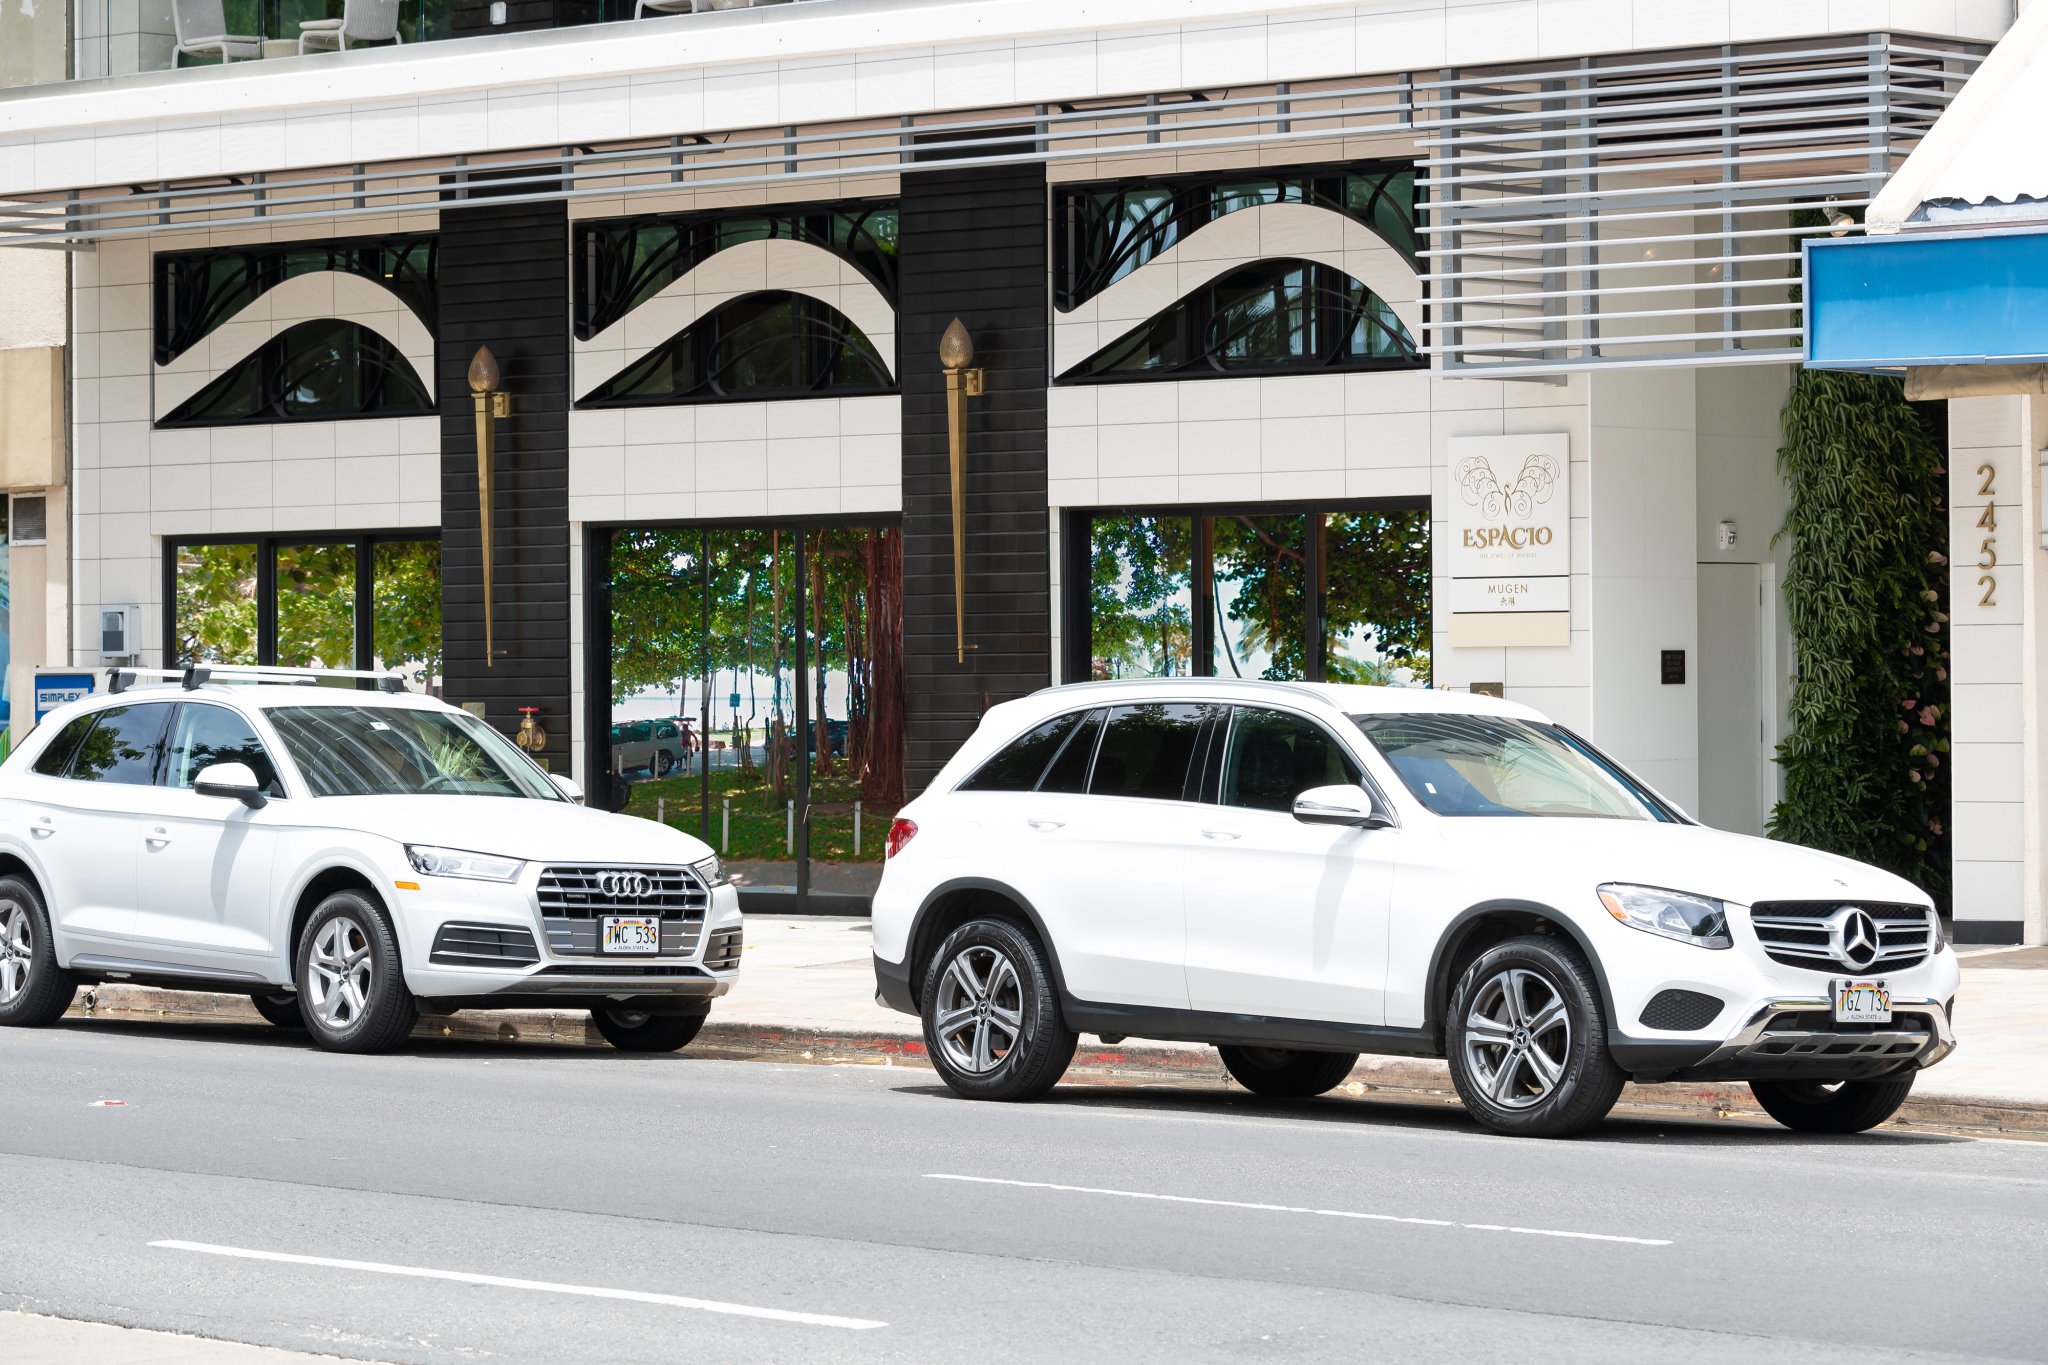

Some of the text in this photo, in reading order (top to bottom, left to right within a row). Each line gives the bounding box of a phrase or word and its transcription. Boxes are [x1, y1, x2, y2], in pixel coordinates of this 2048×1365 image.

[1463, 524, 1553, 550] ESPACIO
[1976, 464, 1997, 607] 2452
[1488, 584, 1528, 594] MUGEN
[40, 693, 81, 702] SIMPLEX
[607, 926, 656, 943] TWC 533
[1840, 990, 1889, 1011] TGZ 732
